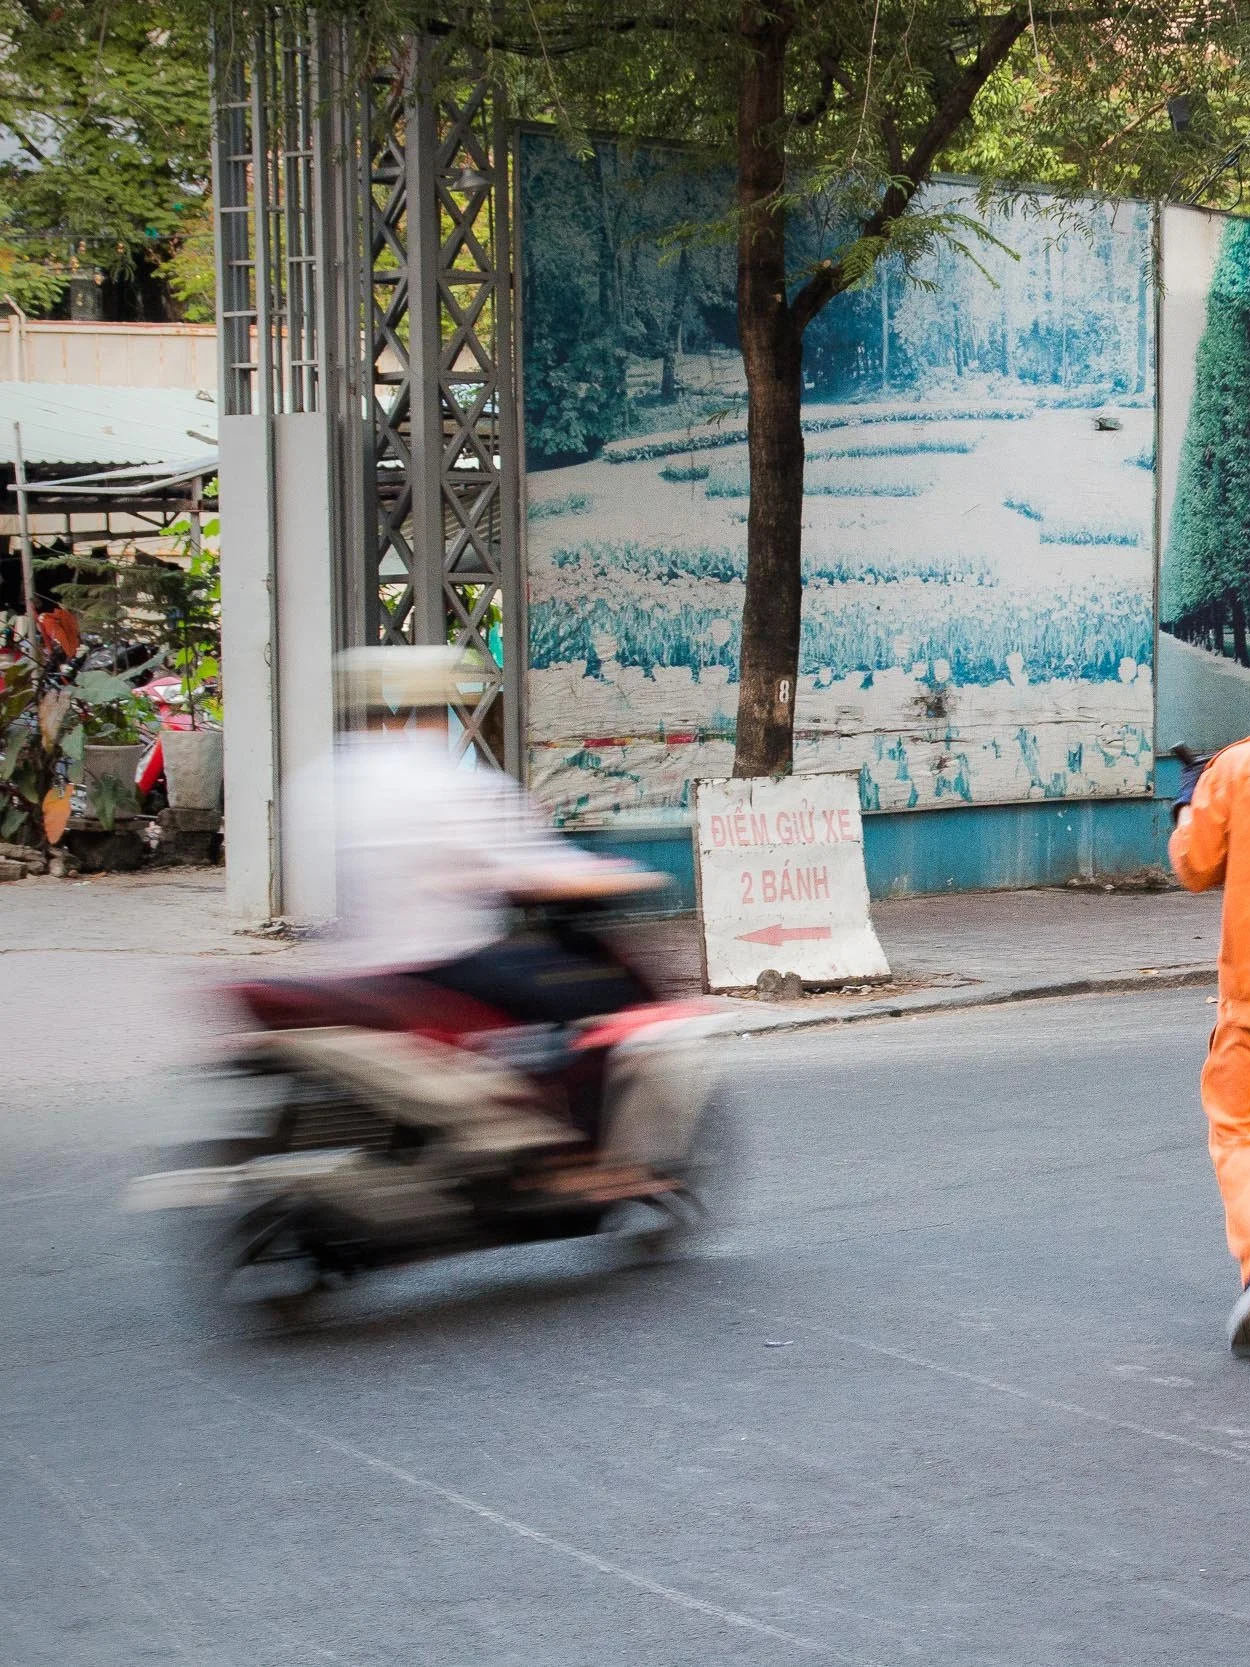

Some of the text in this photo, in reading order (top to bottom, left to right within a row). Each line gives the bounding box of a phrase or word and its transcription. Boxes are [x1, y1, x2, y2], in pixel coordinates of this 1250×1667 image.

[779, 679, 790, 704] 8
[711, 798, 771, 848] ĐIỂM
[822, 809, 855, 843] XE
[741, 859, 831, 905] 2 BÁNH
